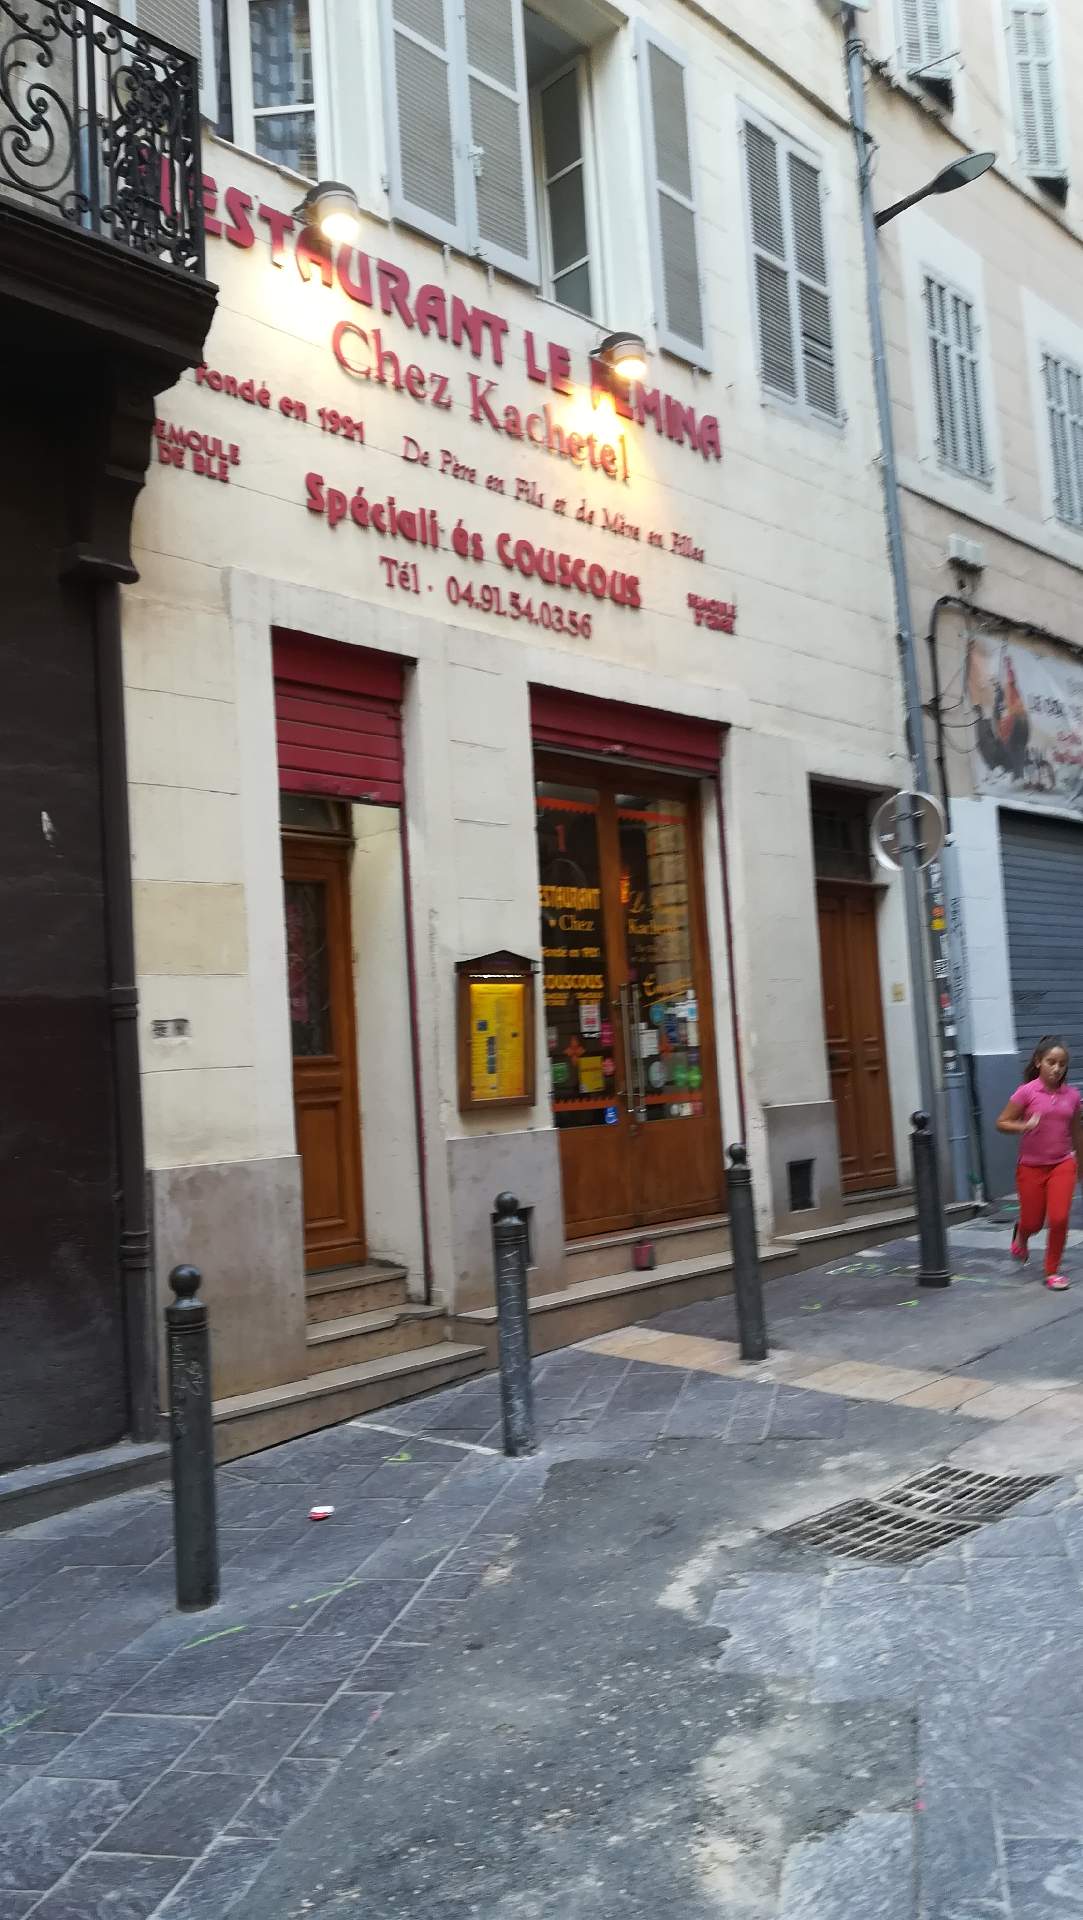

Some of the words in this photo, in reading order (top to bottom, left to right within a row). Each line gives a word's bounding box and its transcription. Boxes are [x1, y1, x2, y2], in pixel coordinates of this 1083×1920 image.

[525, 330, 572, 395] LE
[279, 396, 307, 423] en
[332, 320, 452, 410] Chez
[467, 372, 630, 482] Kachetel
[153, 418, 241, 466] EMOULE
[158, 442, 184, 469] DE
[402, 435, 430, 467] De
[558, 914, 595, 932] Chez
